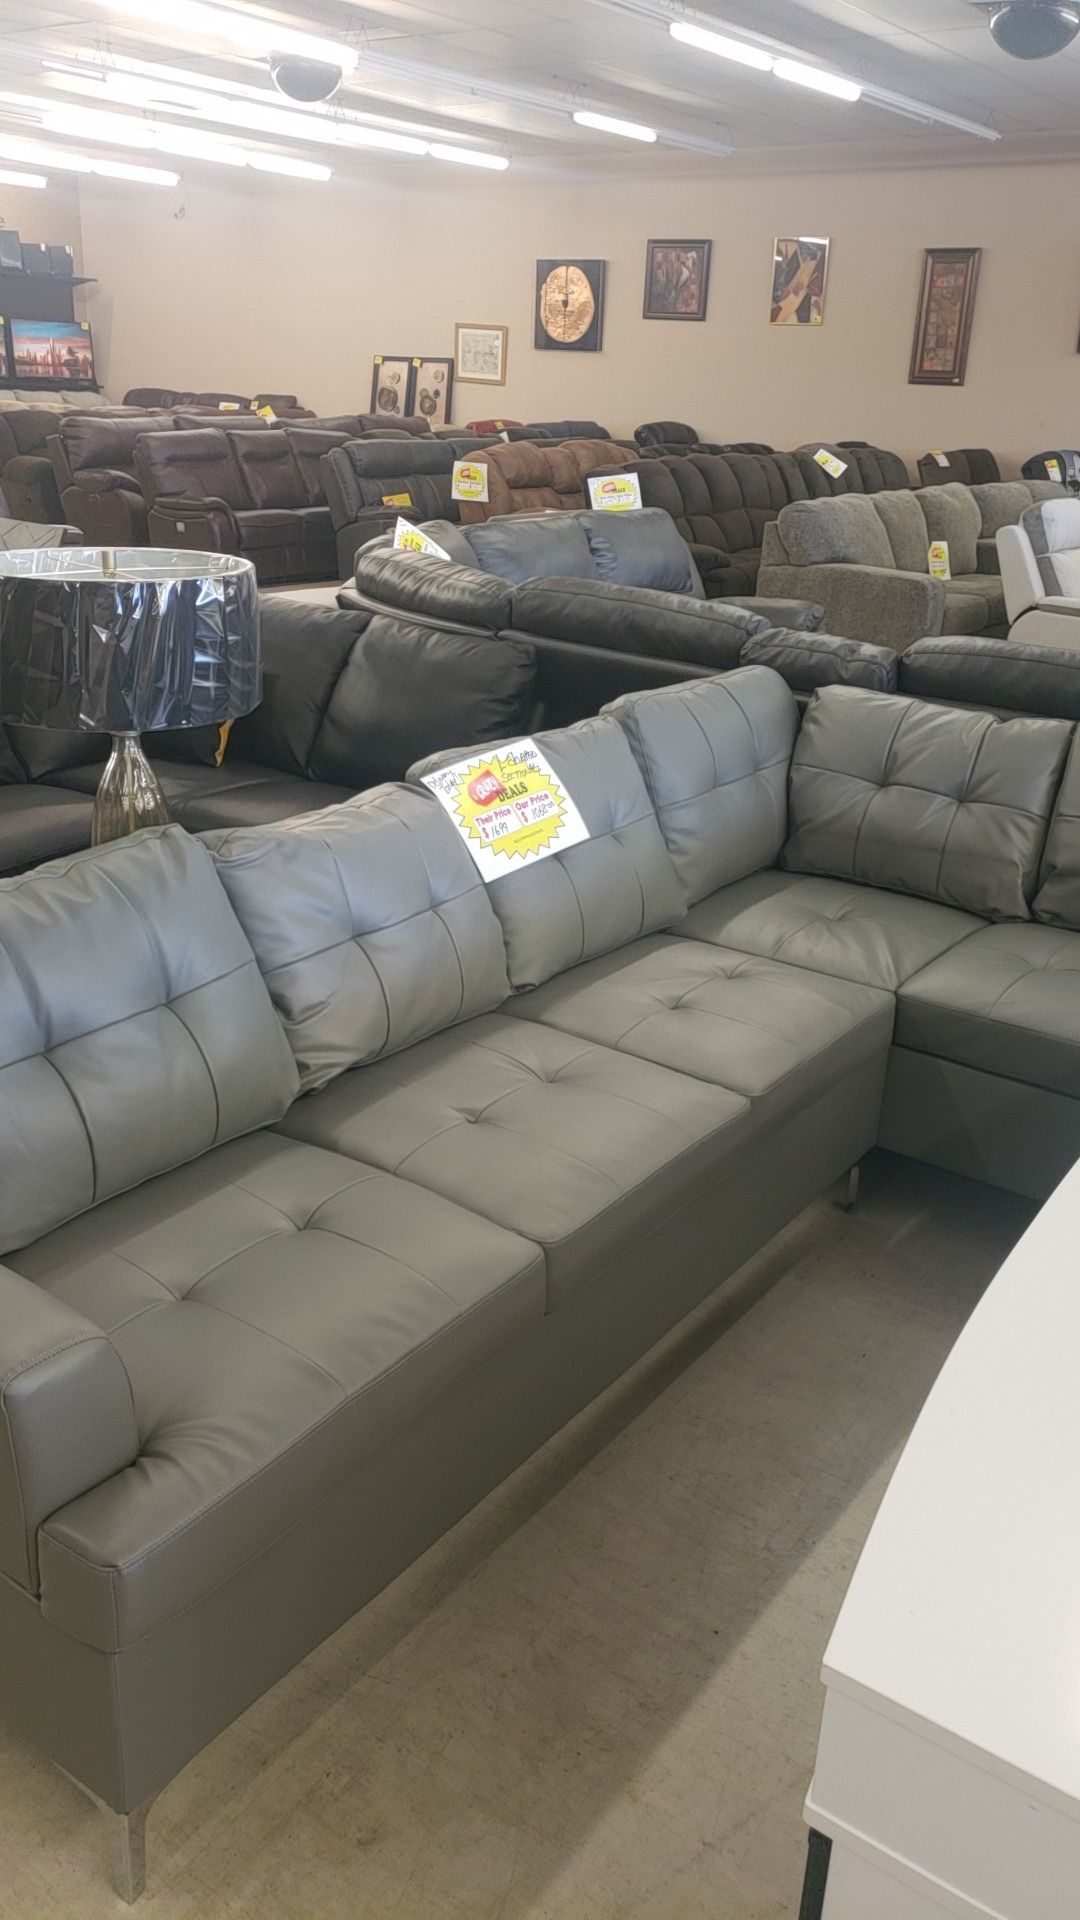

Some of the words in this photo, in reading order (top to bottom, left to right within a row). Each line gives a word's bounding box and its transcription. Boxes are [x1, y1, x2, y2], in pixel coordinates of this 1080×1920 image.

[495, 782, 528, 802] DEALS
[515, 800, 529, 811] Our
[529, 793, 549, 807] Price
[475, 812, 494, 827] Their
[494, 806, 512, 819] Price
